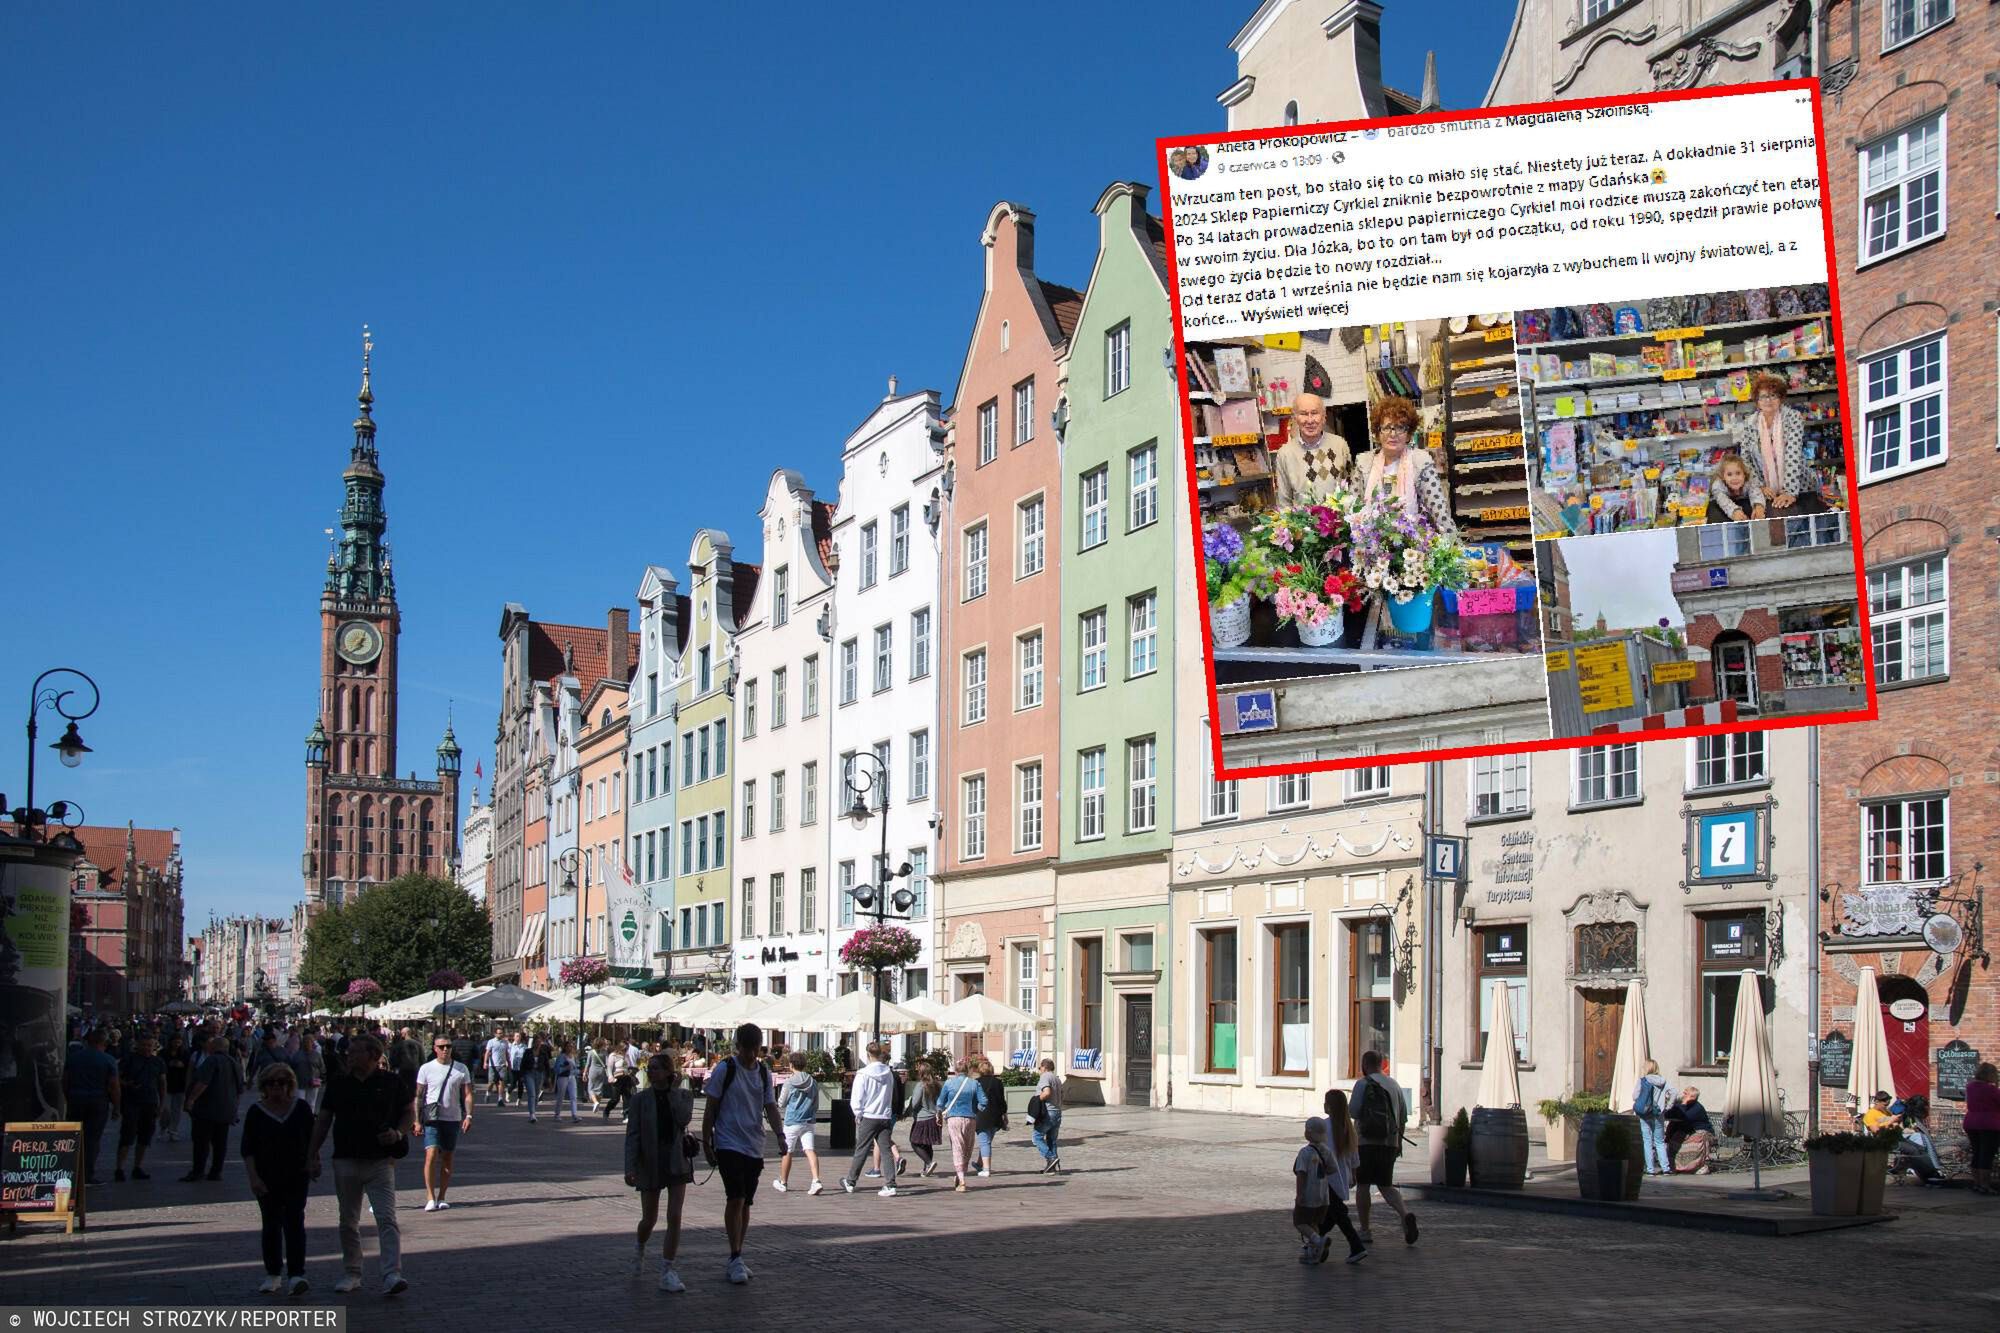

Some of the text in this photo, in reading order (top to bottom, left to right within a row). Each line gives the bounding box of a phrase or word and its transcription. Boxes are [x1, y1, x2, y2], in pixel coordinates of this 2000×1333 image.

[1501, 830, 1534, 847] Gdańskie
[1502, 851, 1533, 865] Centrum
[1495, 867, 1533, 885] Informacji
[1487, 886, 1533, 905] Turystycznej
[12, 1139, 50, 1153] APEROL
[20, 1153, 58, 1173] MOJITO
[2, 1170, 39, 1184] PORNSTAR
